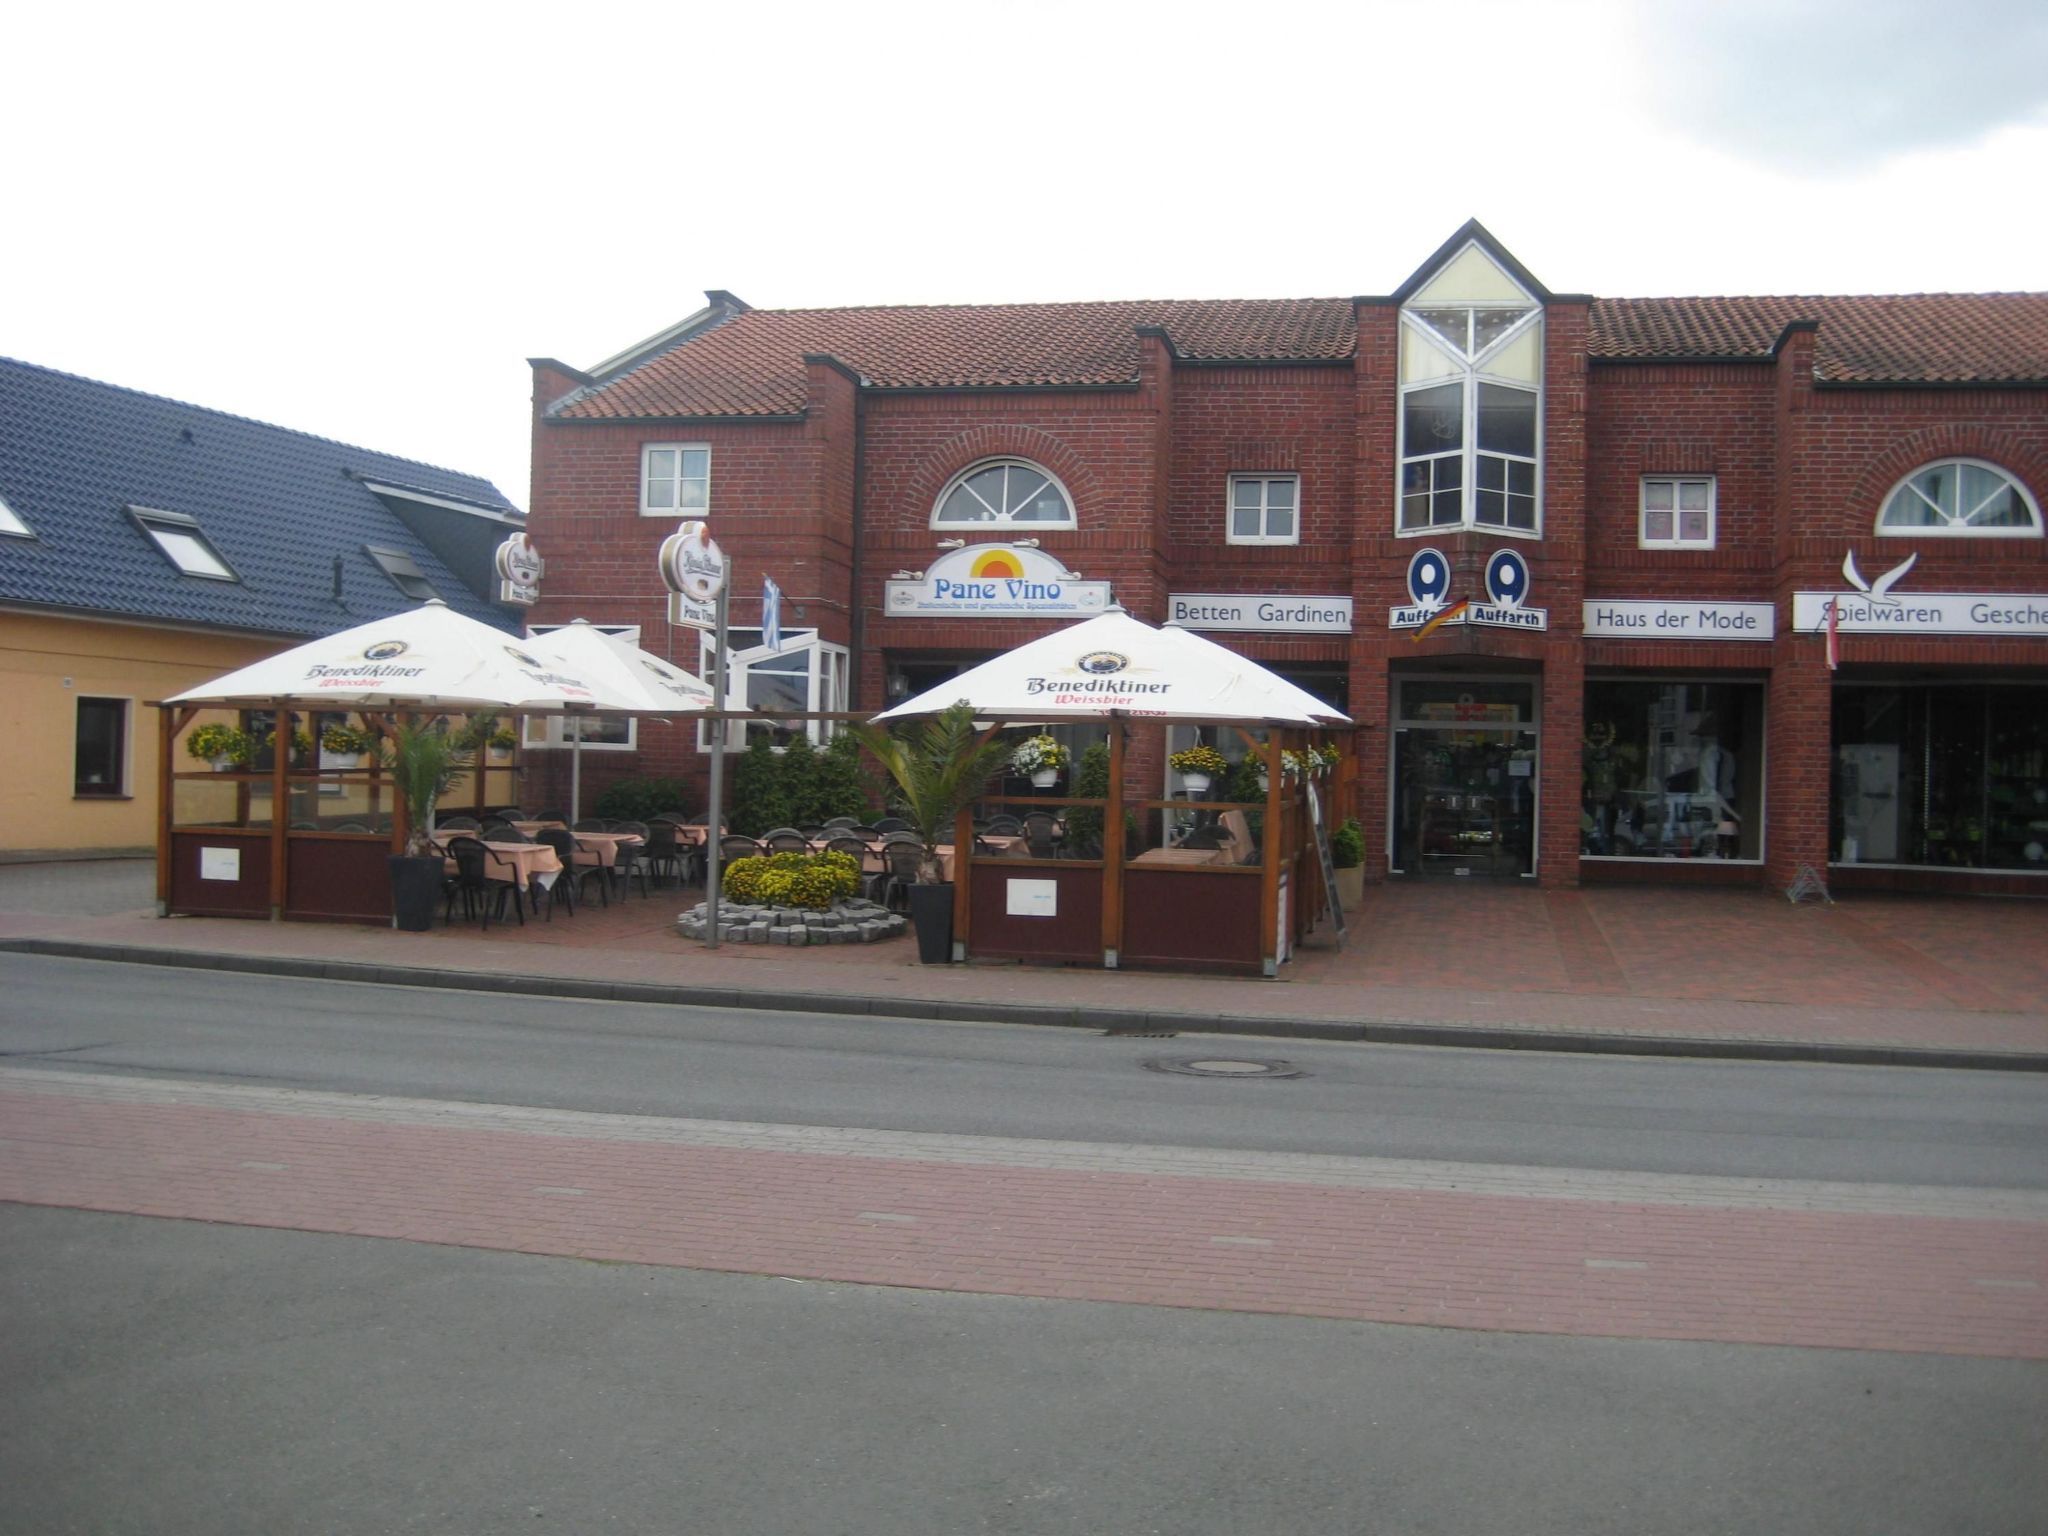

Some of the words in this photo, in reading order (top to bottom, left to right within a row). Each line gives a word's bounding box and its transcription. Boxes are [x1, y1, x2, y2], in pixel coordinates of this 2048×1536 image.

[935, 578, 996, 599] Pane
[1004, 579, 1061, 599] Vino
[1175, 602, 1242, 621] Betten
[1257, 603, 1346, 623] Gardinen
[1475, 607, 1539, 626] Auffarth
[1597, 608, 1647, 627] Haus
[1655, 609, 1689, 628] der
[1699, 610, 1757, 629] Mode
[303, 664, 425, 680] Benediktiner
[1026, 678, 1171, 695] Benediktiner
[1054, 694, 1134, 705] Weissbier
